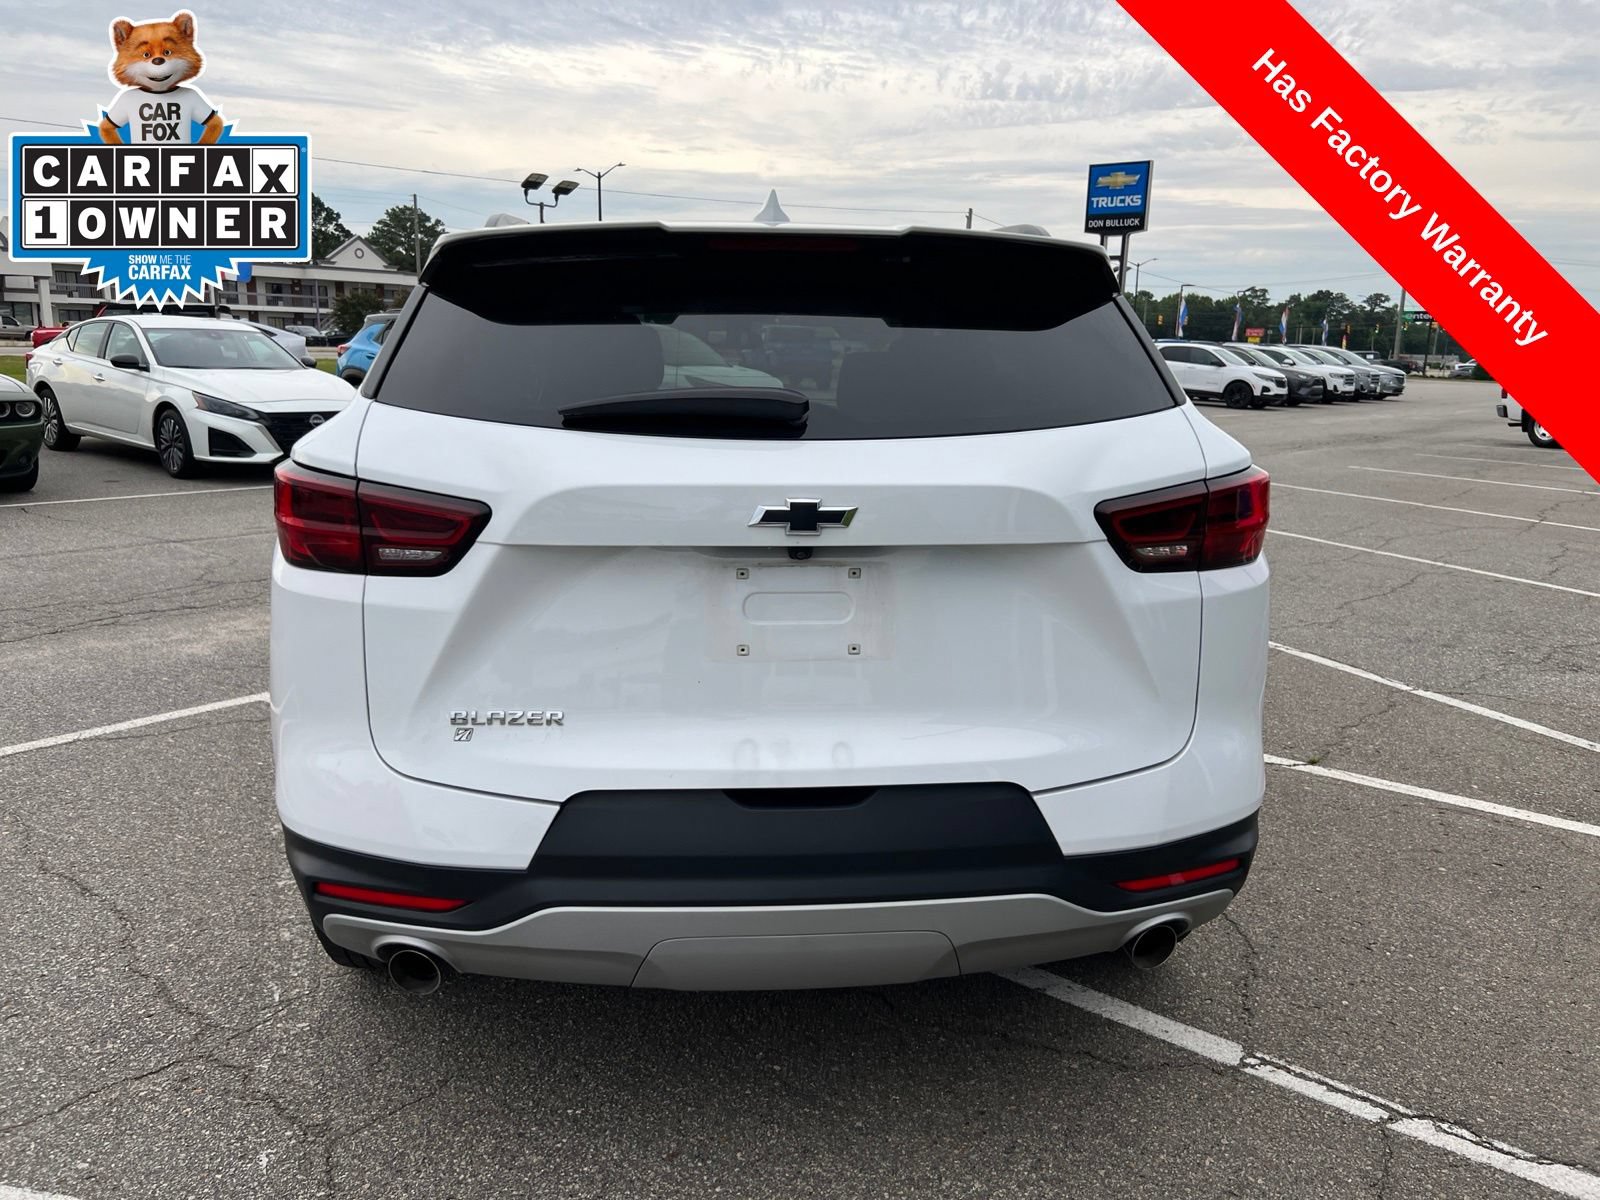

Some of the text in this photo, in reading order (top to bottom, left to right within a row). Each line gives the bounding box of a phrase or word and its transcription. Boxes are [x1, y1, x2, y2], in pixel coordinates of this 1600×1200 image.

[1091, 194, 1142, 209] TRUCKS
[1088, 217, 1140, 228] DON BULLUCK
[449, 709, 565, 727] BLAZER
